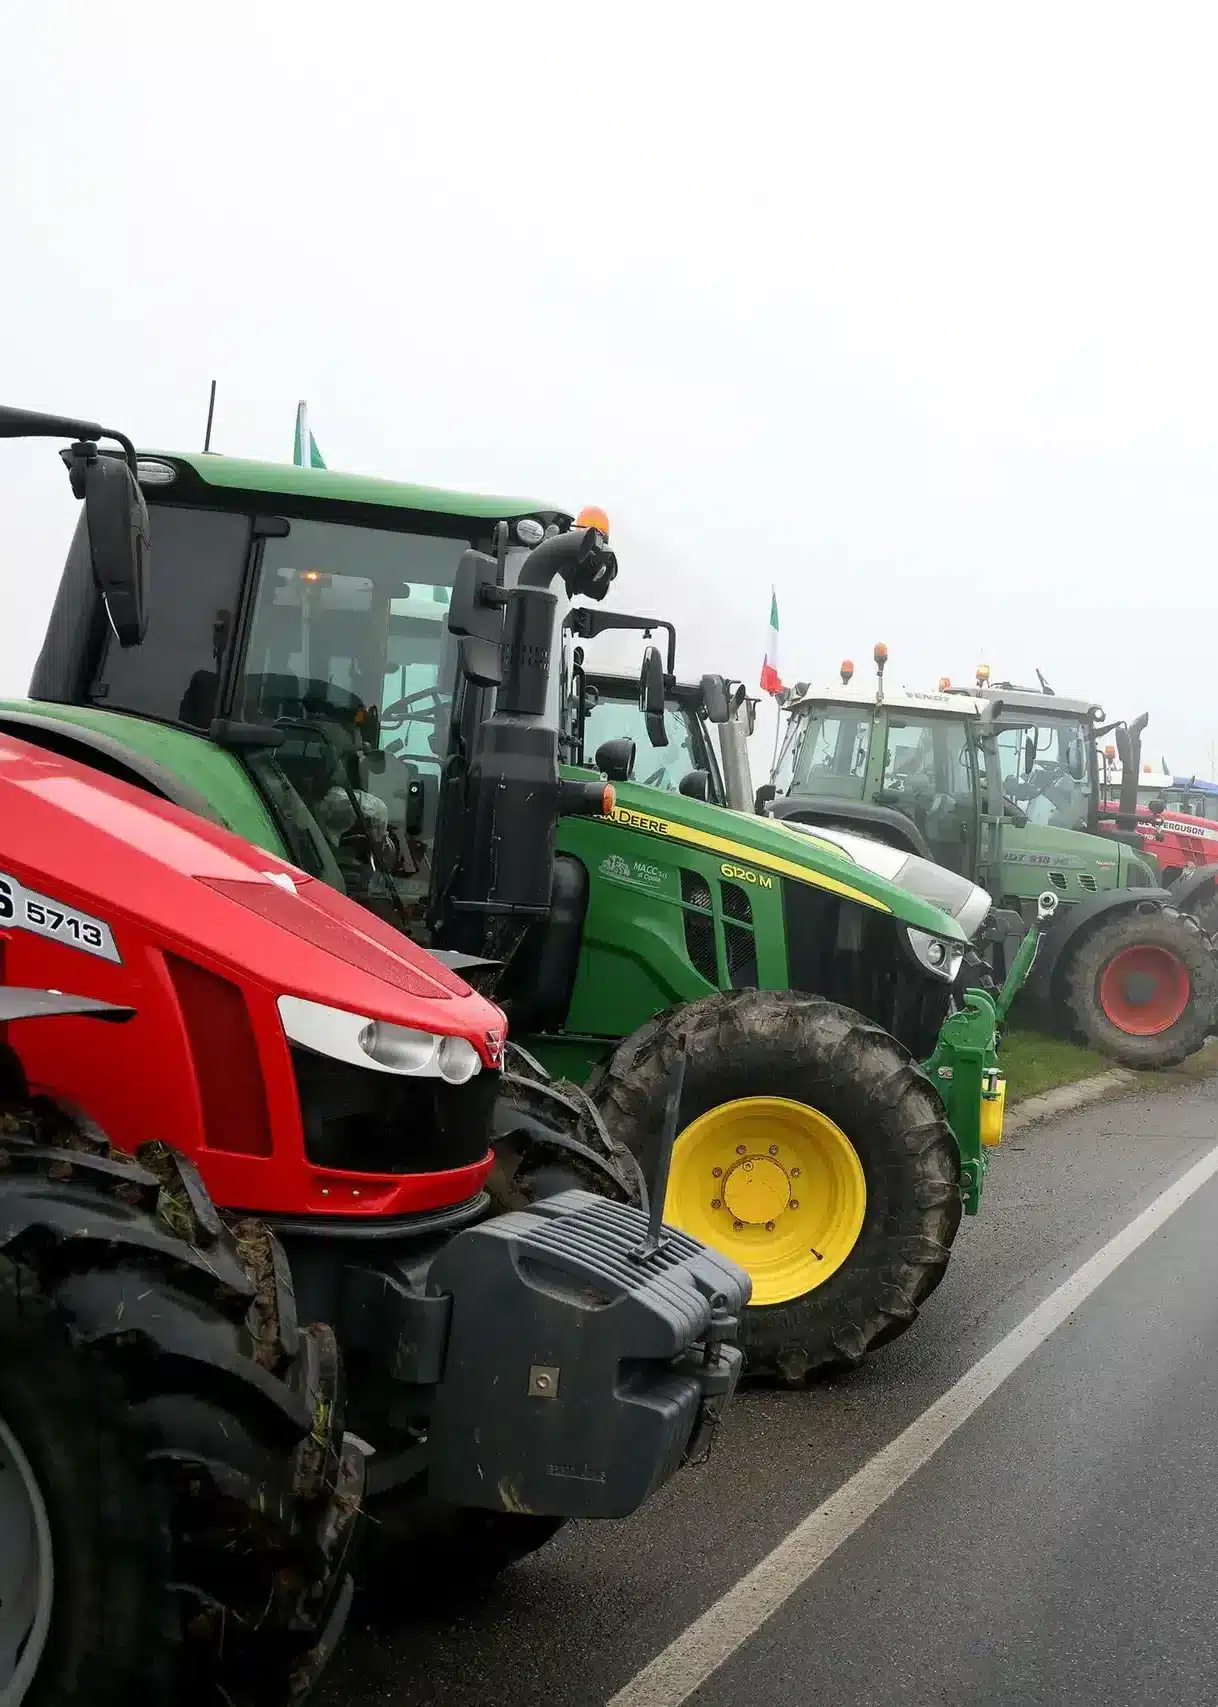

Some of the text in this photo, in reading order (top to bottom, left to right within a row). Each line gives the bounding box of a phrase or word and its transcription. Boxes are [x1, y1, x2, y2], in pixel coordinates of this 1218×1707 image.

[619, 810, 669, 834] DEERE
[633, 862, 658, 875] MACC
[720, 863, 772, 889] 6120 M
[26, 900, 103, 948] 5713
